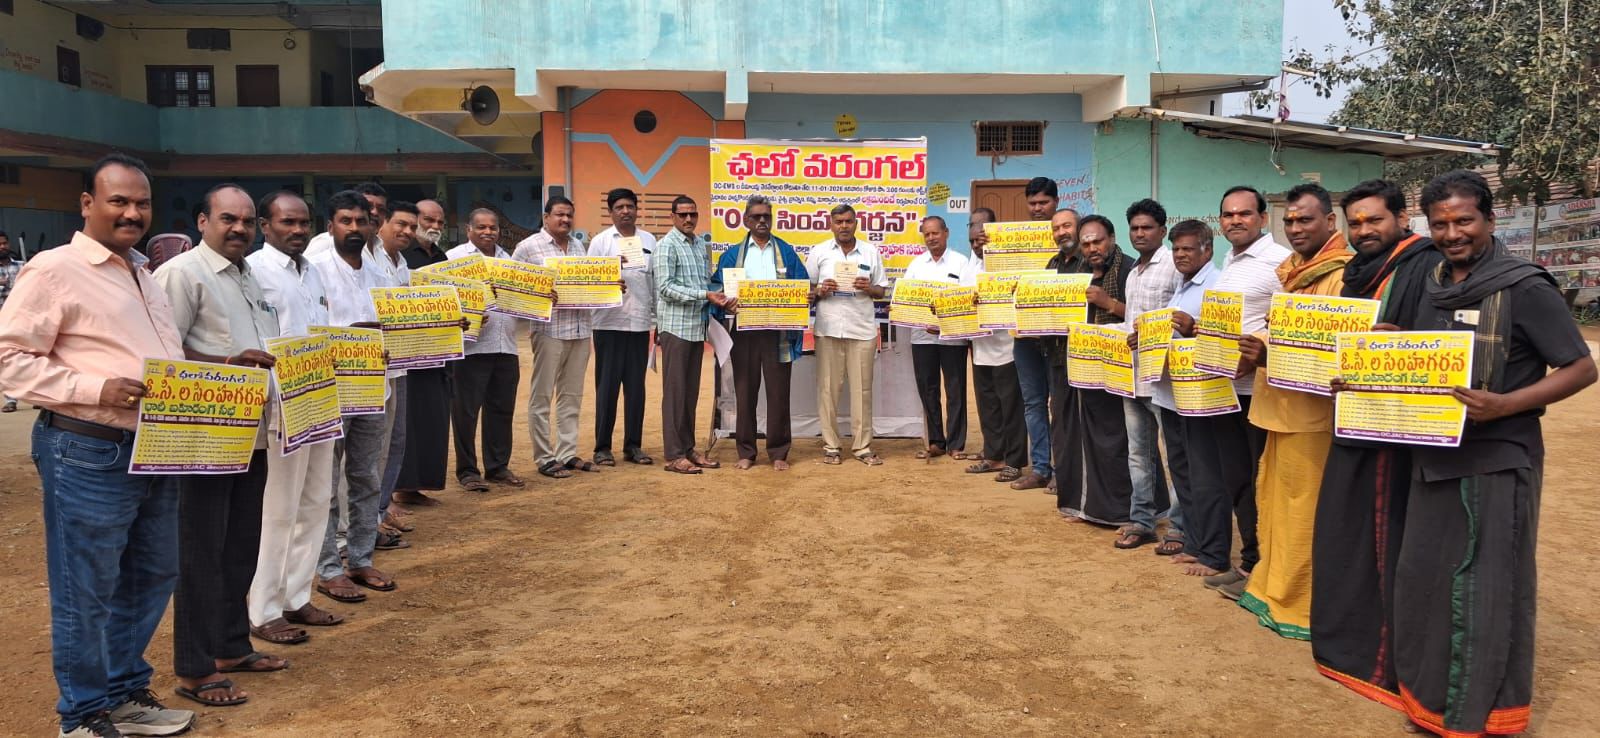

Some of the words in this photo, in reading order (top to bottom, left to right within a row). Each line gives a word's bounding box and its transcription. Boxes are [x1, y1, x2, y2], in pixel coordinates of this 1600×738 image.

[727, 149, 800, 180] ఛలో
[804, 153, 928, 180] వరంగల్
[949, 199, 967, 209] OUT
[1294, 316, 1304, 329] ల
[1369, 340, 1394, 350] ఛలో
[1397, 339, 1441, 349] వరంగల్
[1370, 356, 1381, 371] ల
[178, 369, 203, 380] ఛలో
[204, 371, 247, 384] వరంగల్
[1409, 372, 1429, 384] సభ
[179, 386, 191, 401] ల
[218, 405, 236, 418] సభ
